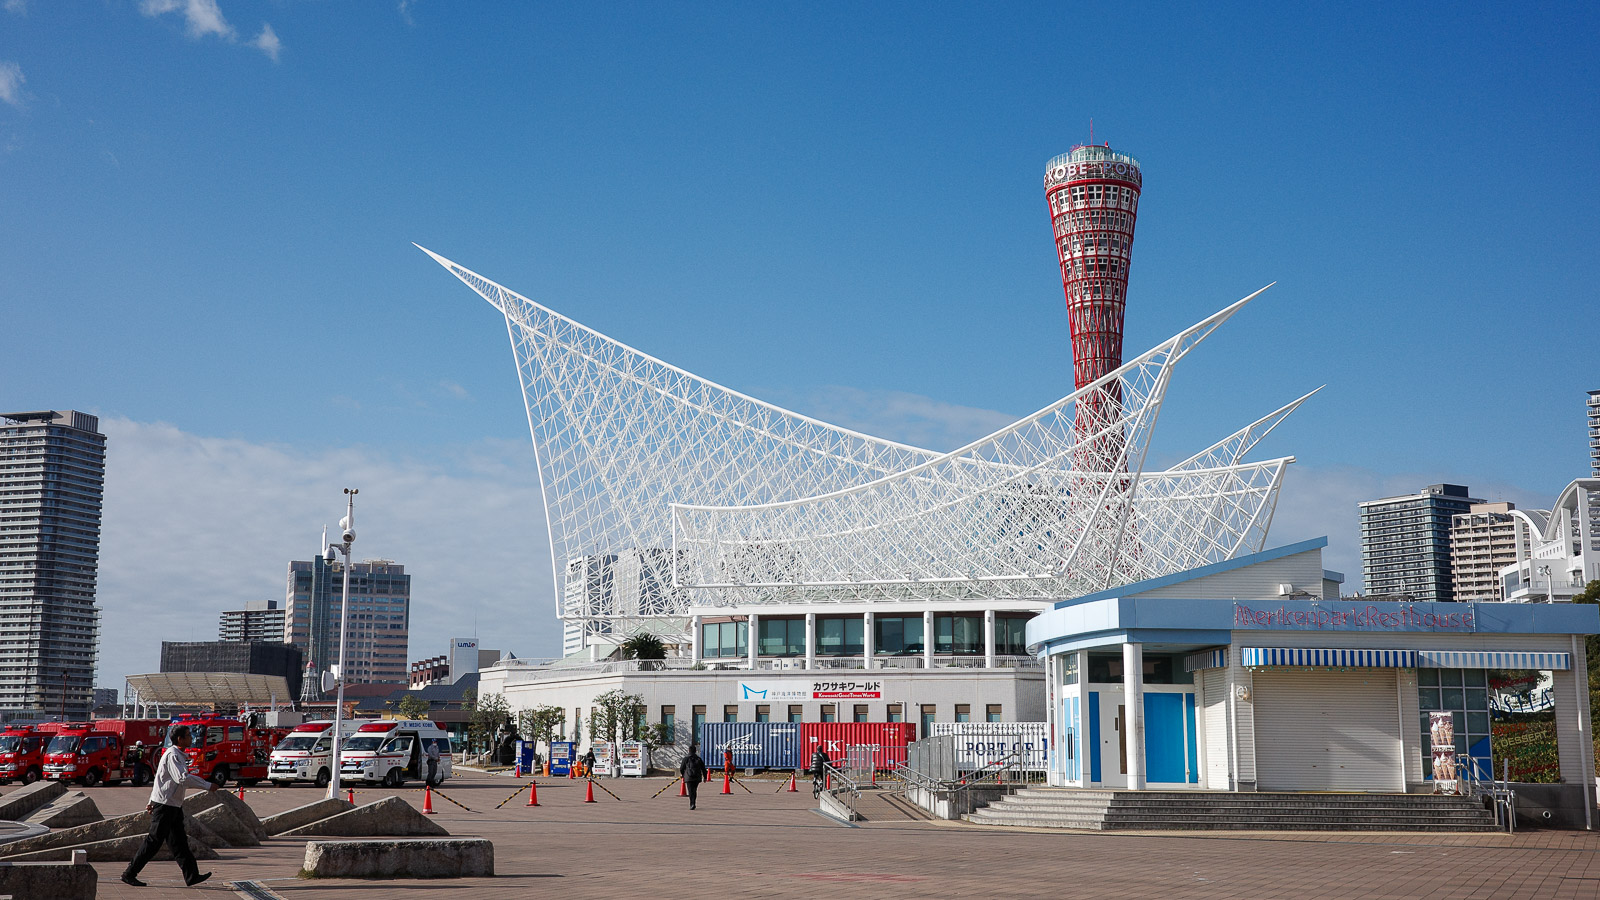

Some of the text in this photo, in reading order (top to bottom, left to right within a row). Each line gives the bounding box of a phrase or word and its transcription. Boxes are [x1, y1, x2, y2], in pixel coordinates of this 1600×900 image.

[1048, 162, 1087, 183] KOBE
[1103, 161, 1140, 181] PORT
[813, 682, 881, 691] カワサキワールド
[1501, 731, 1547, 747] DESSERT
[965, 742, 1006, 756] PORT
